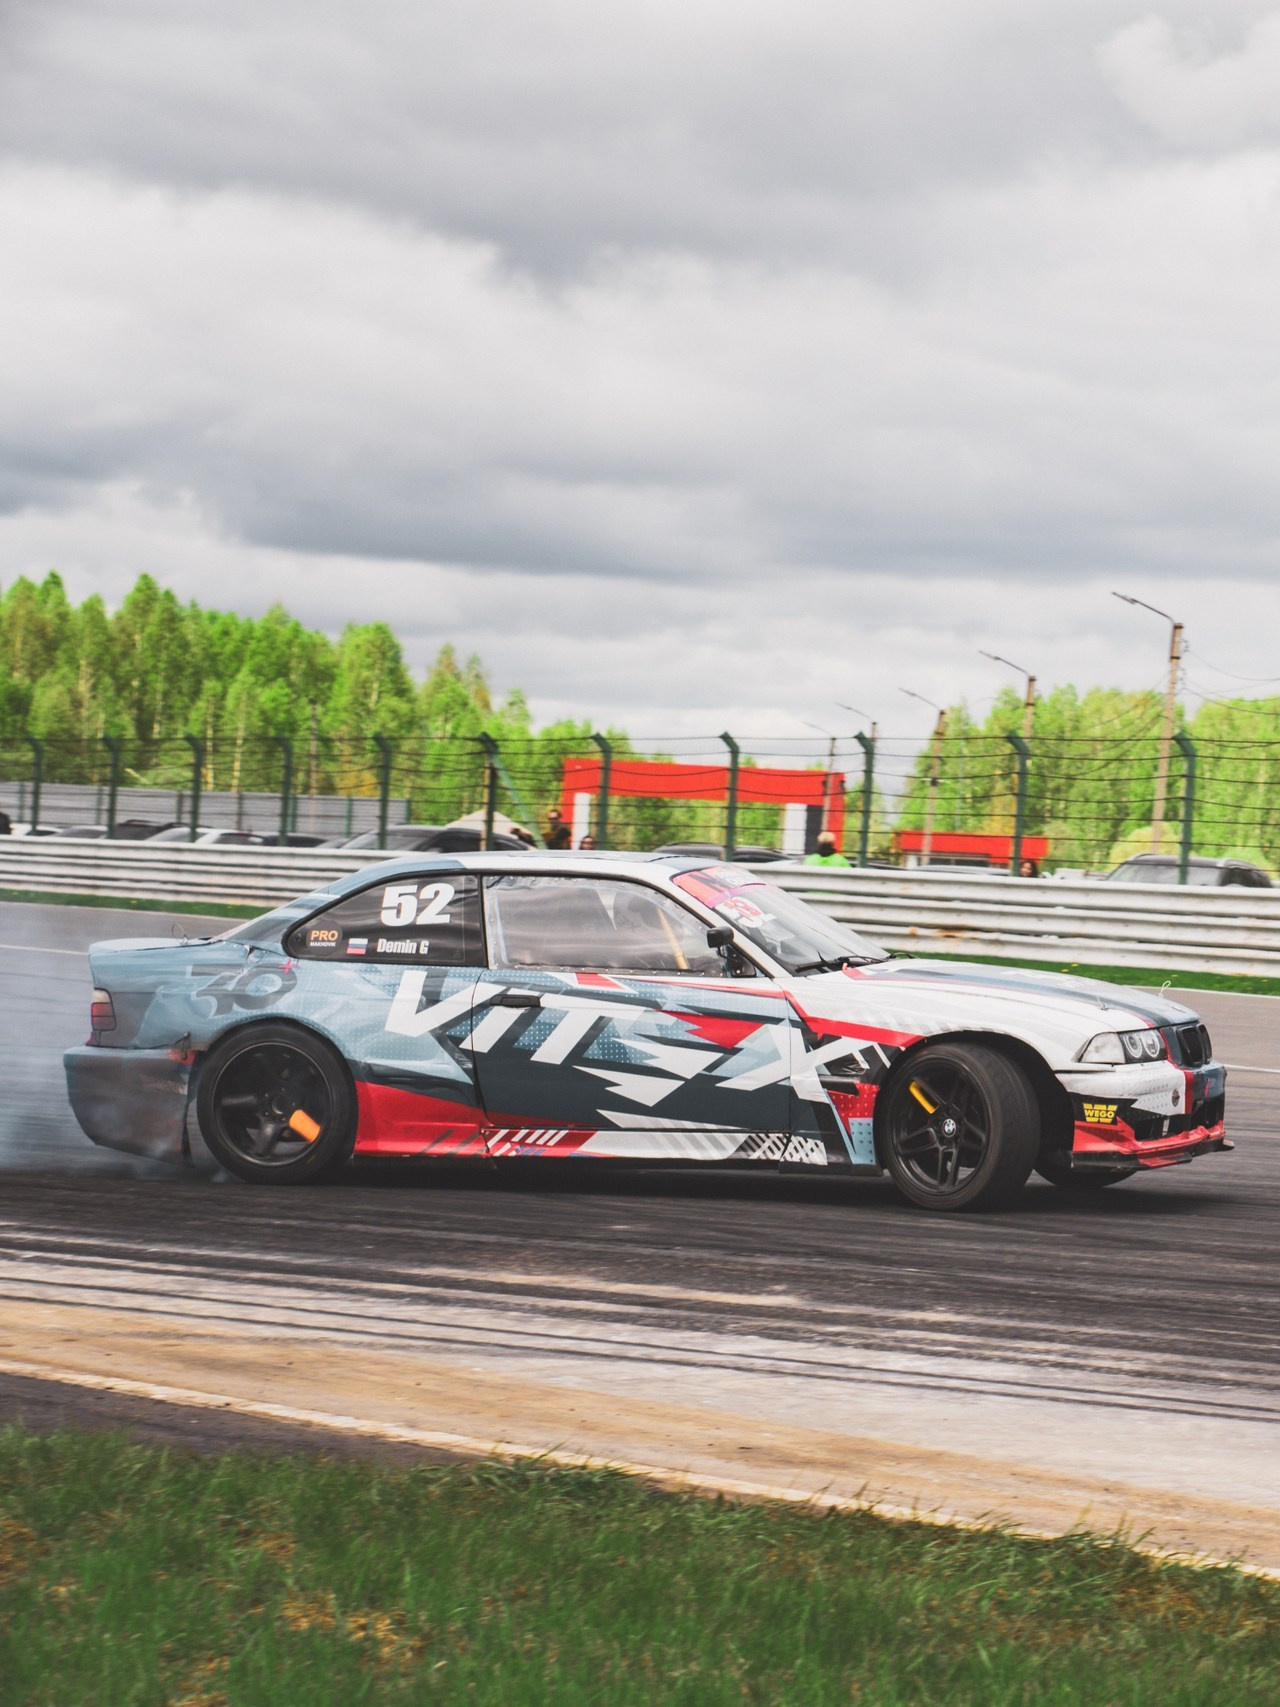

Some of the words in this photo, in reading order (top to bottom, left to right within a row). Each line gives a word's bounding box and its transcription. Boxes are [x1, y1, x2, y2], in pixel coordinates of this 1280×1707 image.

[381, 882, 455, 927] 52
[310, 929, 338, 941] PRO
[377, 938, 417, 954] Demin
[419, 940, 430, 955] G
[1084, 1109, 1115, 1119] WEGO
